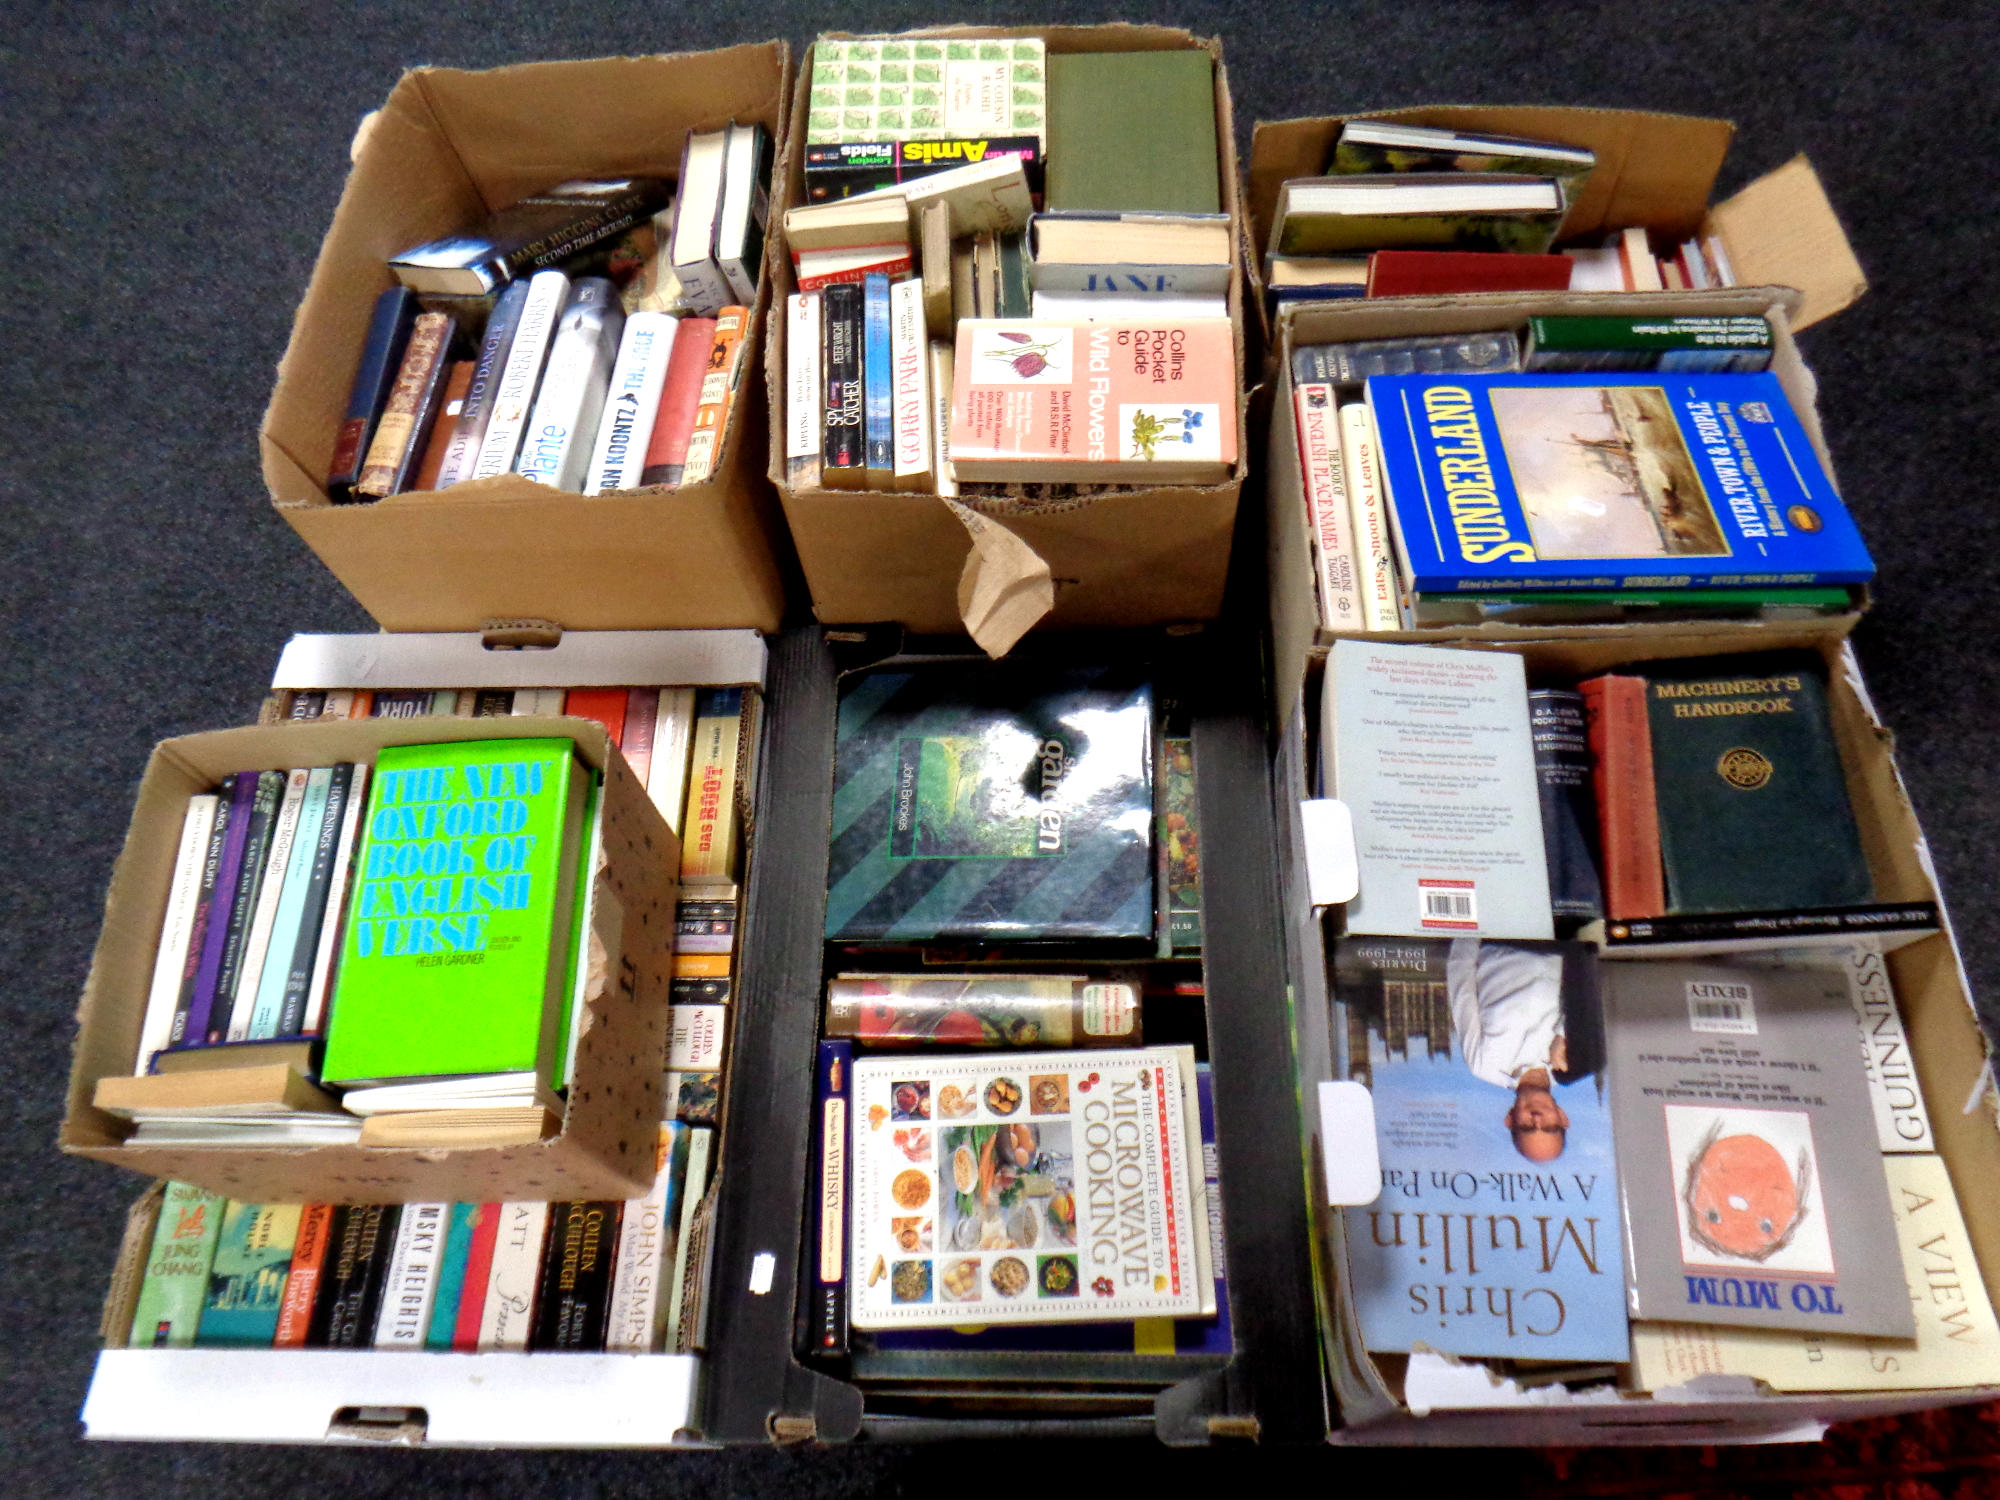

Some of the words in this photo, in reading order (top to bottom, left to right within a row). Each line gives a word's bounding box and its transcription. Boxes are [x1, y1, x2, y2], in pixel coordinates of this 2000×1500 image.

[840, 144, 893, 158] Fields
[846, 156, 892, 165] London
[903, 140, 988, 162] Amis
[510, 239, 547, 265] MARY
[534, 243, 570, 267] SECOND
[627, 330, 655, 359] FACE
[832, 321, 844, 345] WRIGHT
[1087, 326, 1110, 374] Wild
[1117, 330, 1129, 346] to
[1134, 329, 1149, 376] Guide
[1696, 333, 1714, 344] the
[1714, 333, 1726, 344] to
[1728, 331, 1758, 345] guide
[1758, 333, 1768, 345] A
[466, 379, 485, 419] INTO
[478, 322, 505, 379] DANGER
[832, 344, 844, 364] PETER
[898, 346, 919, 394] PARK
[1151, 329, 1168, 384] Pocket
[1169, 329, 1185, 382] Collins
[623, 362, 649, 391] THE
[827, 407, 843, 426] SPY
[842, 379, 860, 426] CATCHER
[1050, 390, 1059, 405] and
[1062, 390, 1072, 412] David
[606, 407, 638, 466] KOONTZ
[899, 400, 921, 464] GORKY
[1087, 377, 1110, 460] Flowers
[1307, 412, 1327, 462] ENGLISH
[1685, 401, 1727, 445] PEOPLE
[523, 424, 568, 486] Plante
[1328, 448, 1339, 462] THE
[1329, 463, 1341, 486] BOOK
[1359, 443, 1373, 489] Leaves
[1312, 466, 1332, 507] PLACE
[1331, 486, 1343, 497] OF
[1423, 386, 1537, 564] SUNDERLAND
[1709, 456, 1749, 496] TOWN
[1364, 495, 1376, 507] &
[1728, 493, 1769, 538] RIVER,
[1318, 509, 1337, 551] NAMES
[1327, 556, 1341, 590] TAGGART
[1338, 554, 1352, 593] CAROLINE
[1655, 676, 1802, 699] MACHINERY'S
[1672, 698, 1794, 719] HANDBOOK
[381, 770, 455, 805] THE
[464, 761, 553, 800] NEW
[698, 765, 725, 822] BOOT
[901, 761, 915, 791] John
[217, 799, 229, 832] CAROL
[286, 796, 299, 825] Roger
[318, 785, 342, 852] HAPPENINGS
[372, 799, 530, 842] OXFORD
[897, 790, 913, 832] Brookes
[210, 834, 222, 861] ANN
[248, 839, 259, 869] CAROL
[271, 825, 290, 876] McGough
[364, 838, 476, 880] BOOK
[485, 835, 538, 870] OF
[203, 858, 217, 890] DUFFY
[244, 872, 252, 893] ANN
[237, 895, 248, 927] DUFFY
[359, 872, 534, 920] ENGLISH
[357, 914, 492, 959] VERSE
[1846, 912, 1899, 924] GUINNESS
[415, 955, 445, 968] HELEN
[446, 953, 486, 967] GARDNER
[282, 997, 297, 1032] HARRAP
[673, 1023, 687, 1048] THE
[700, 1018, 714, 1057] COLLEEN
[1854, 952, 1925, 1143] GUINNESS
[830, 1101, 839, 1114] The
[1142, 1095, 1155, 1123] THE
[825, 1148, 840, 1213] WHISKY
[1145, 1126, 1159, 1198] COMPLETE
[1156, 1069, 1170, 1178] PRACTICAL
[1165, 1188, 1180, 1293] HANDBOOK
[1083, 1102, 1119, 1269] COOKING
[1109, 1079, 1150, 1289] MICROWAVE
[1381, 1169, 1420, 1198] Par
[1432, 1169, 1570, 1201] Walk-On
[1574, 1174, 1598, 1202] A
[1901, 1186, 1935, 1215] A
[243, 1210, 259, 1261] HOUSE
[258, 1210, 274, 1258] NOBLE
[295, 1205, 321, 1264] Mercy
[583, 1210, 600, 1272] COLLEEN
[640, 1203, 659, 1264] JOHN
[1149, 1203, 1161, 1249] GUIDE
[1368, 1211, 1604, 1276] Mullin
[151, 1261, 201, 1278] CHANG
[162, 1244, 201, 1261] JUNG
[390, 1236, 409, 1293] Davidson
[1153, 1252, 1164, 1272] TO
[278, 1273, 304, 1343] Unsworth
[298, 1269, 318, 1315] Barry
[402, 1263, 428, 1340] HEIGHTS
[1684, 1275, 1779, 1309] MUM
[1792, 1282, 1843, 1315] TO
[1917, 1233, 1978, 1344] VIEW
[823, 1289, 836, 1332] APPLE
[1408, 1283, 1567, 1338] Chris
